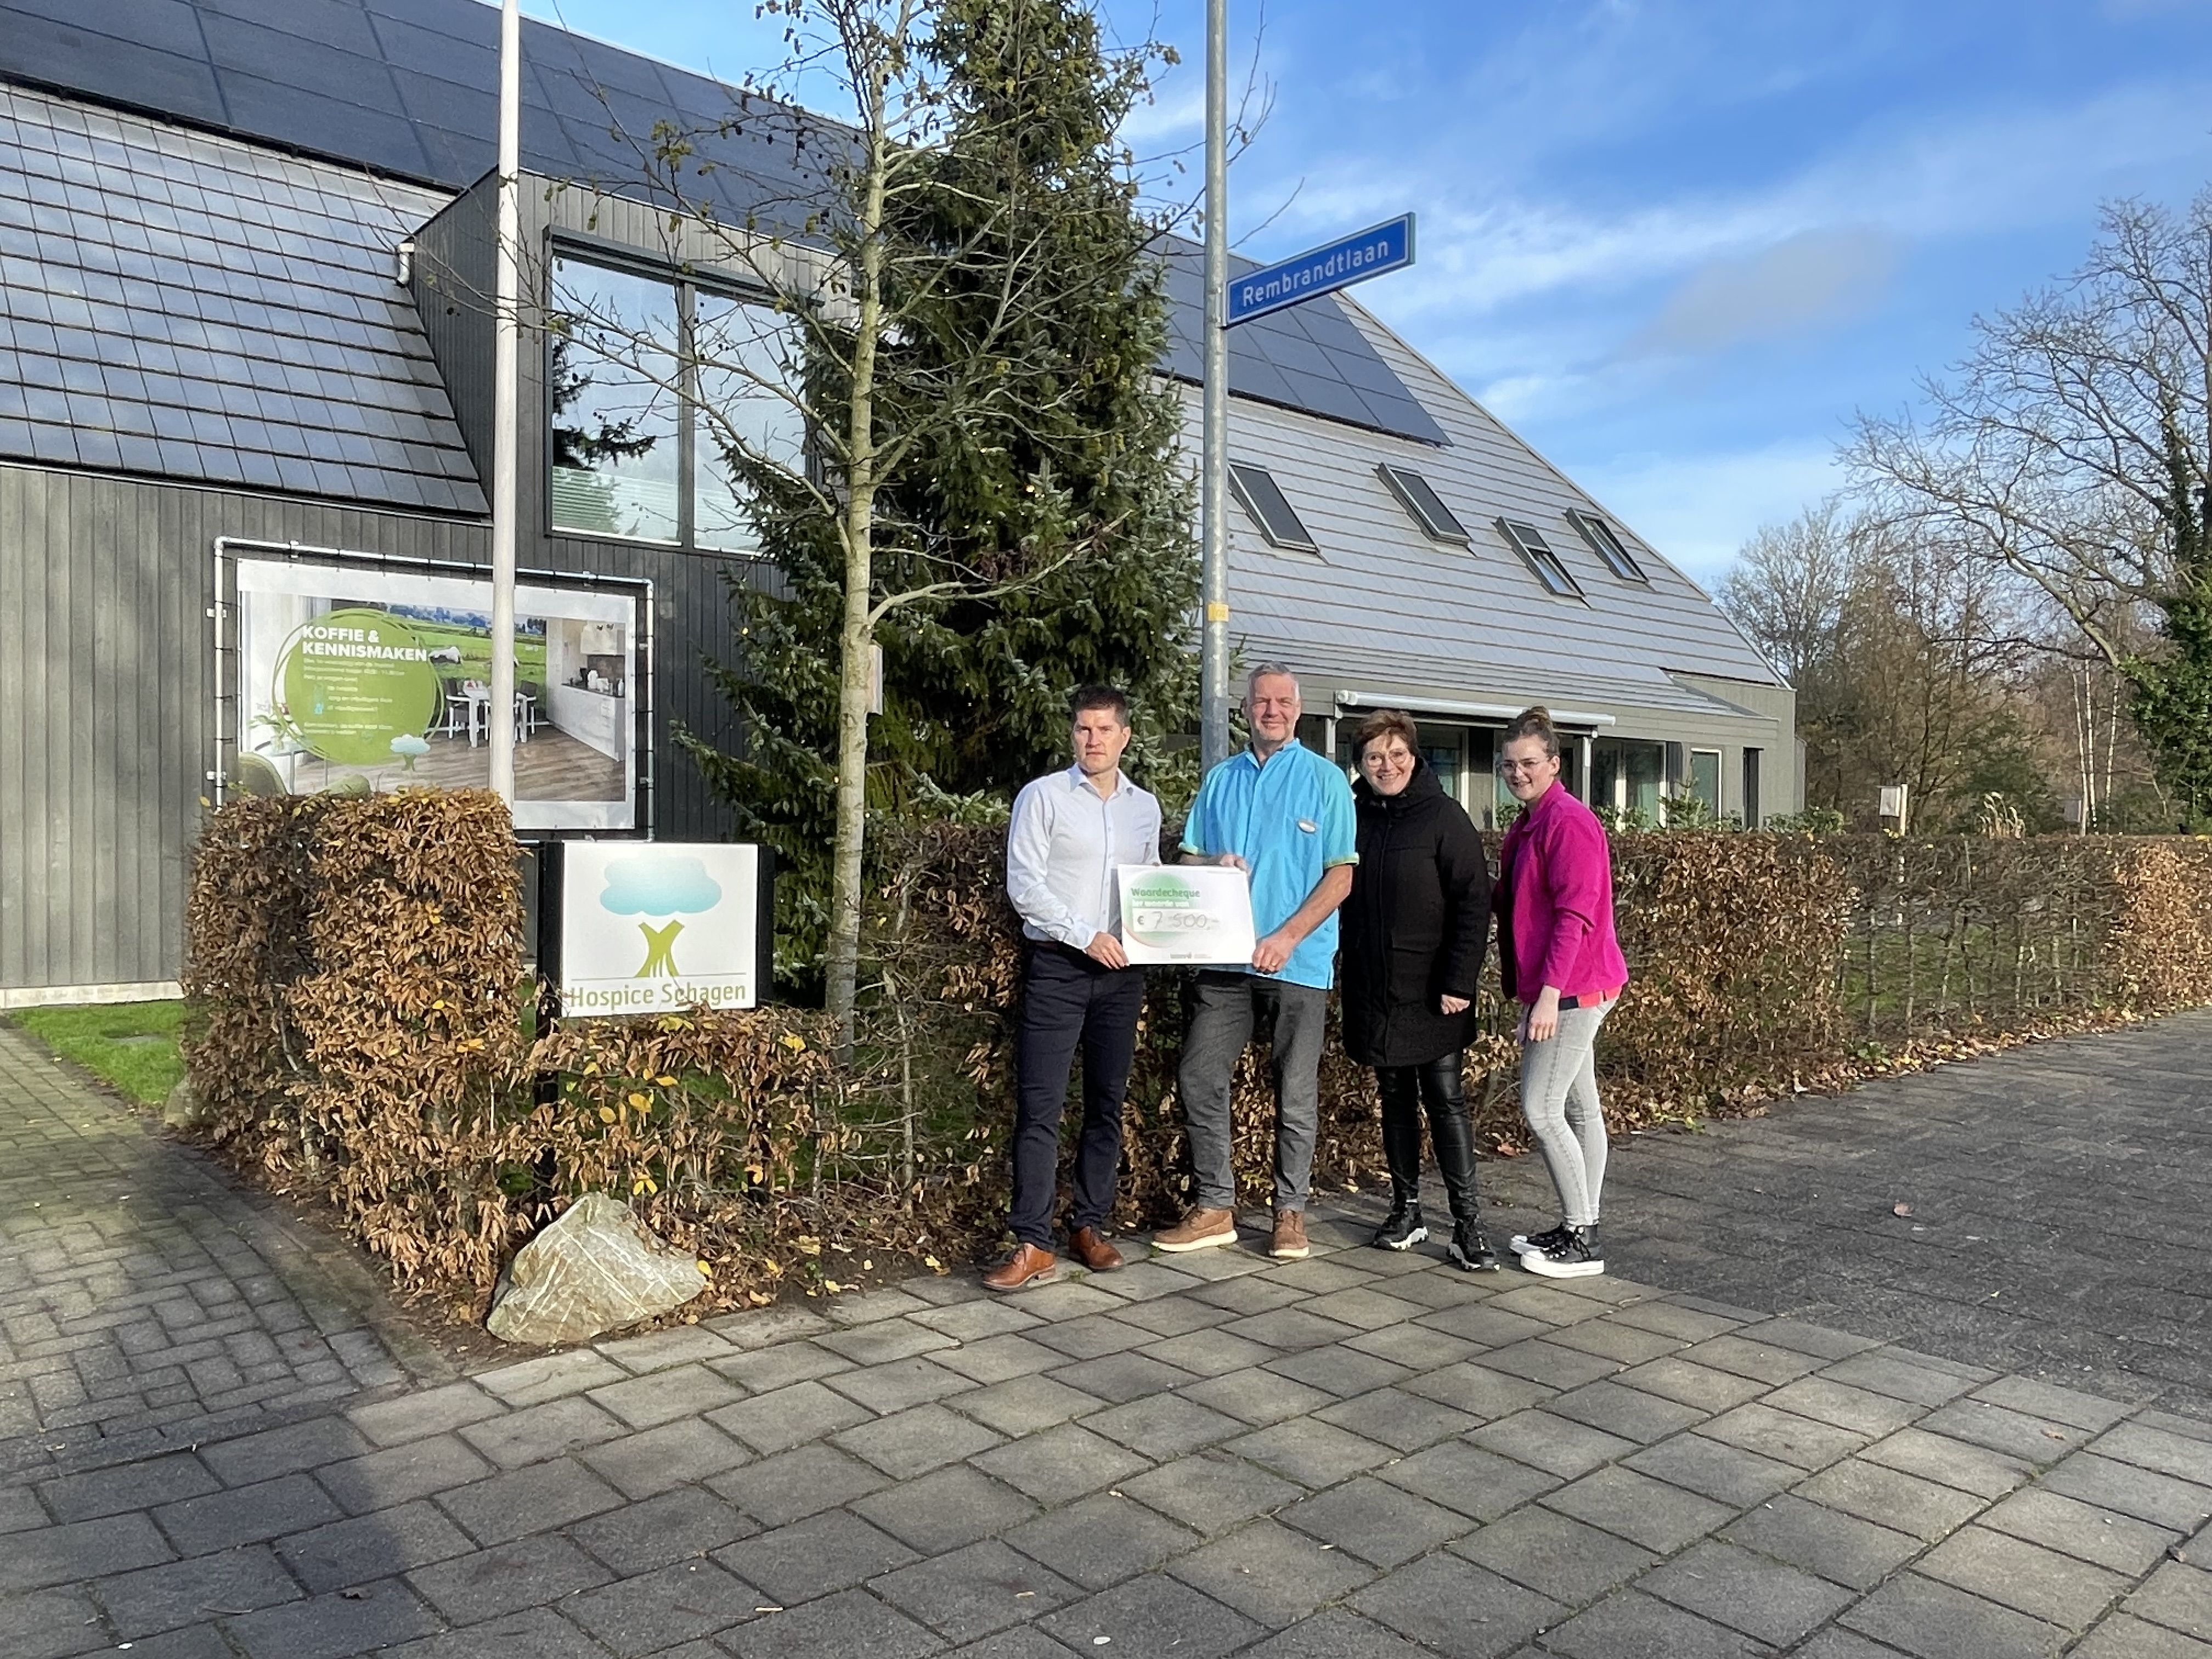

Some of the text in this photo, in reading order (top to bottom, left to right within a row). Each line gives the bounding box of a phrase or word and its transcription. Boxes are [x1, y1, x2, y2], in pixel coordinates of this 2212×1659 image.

[1243, 240, 1389, 307] Rembrandtlaan
[303, 624, 380, 643] KOFFIE &
[303, 641, 427, 662] KENNISMAKEN
[1131, 888, 1200, 900] Waardecheque
[571, 981, 746, 1010] Hospice Schagen
